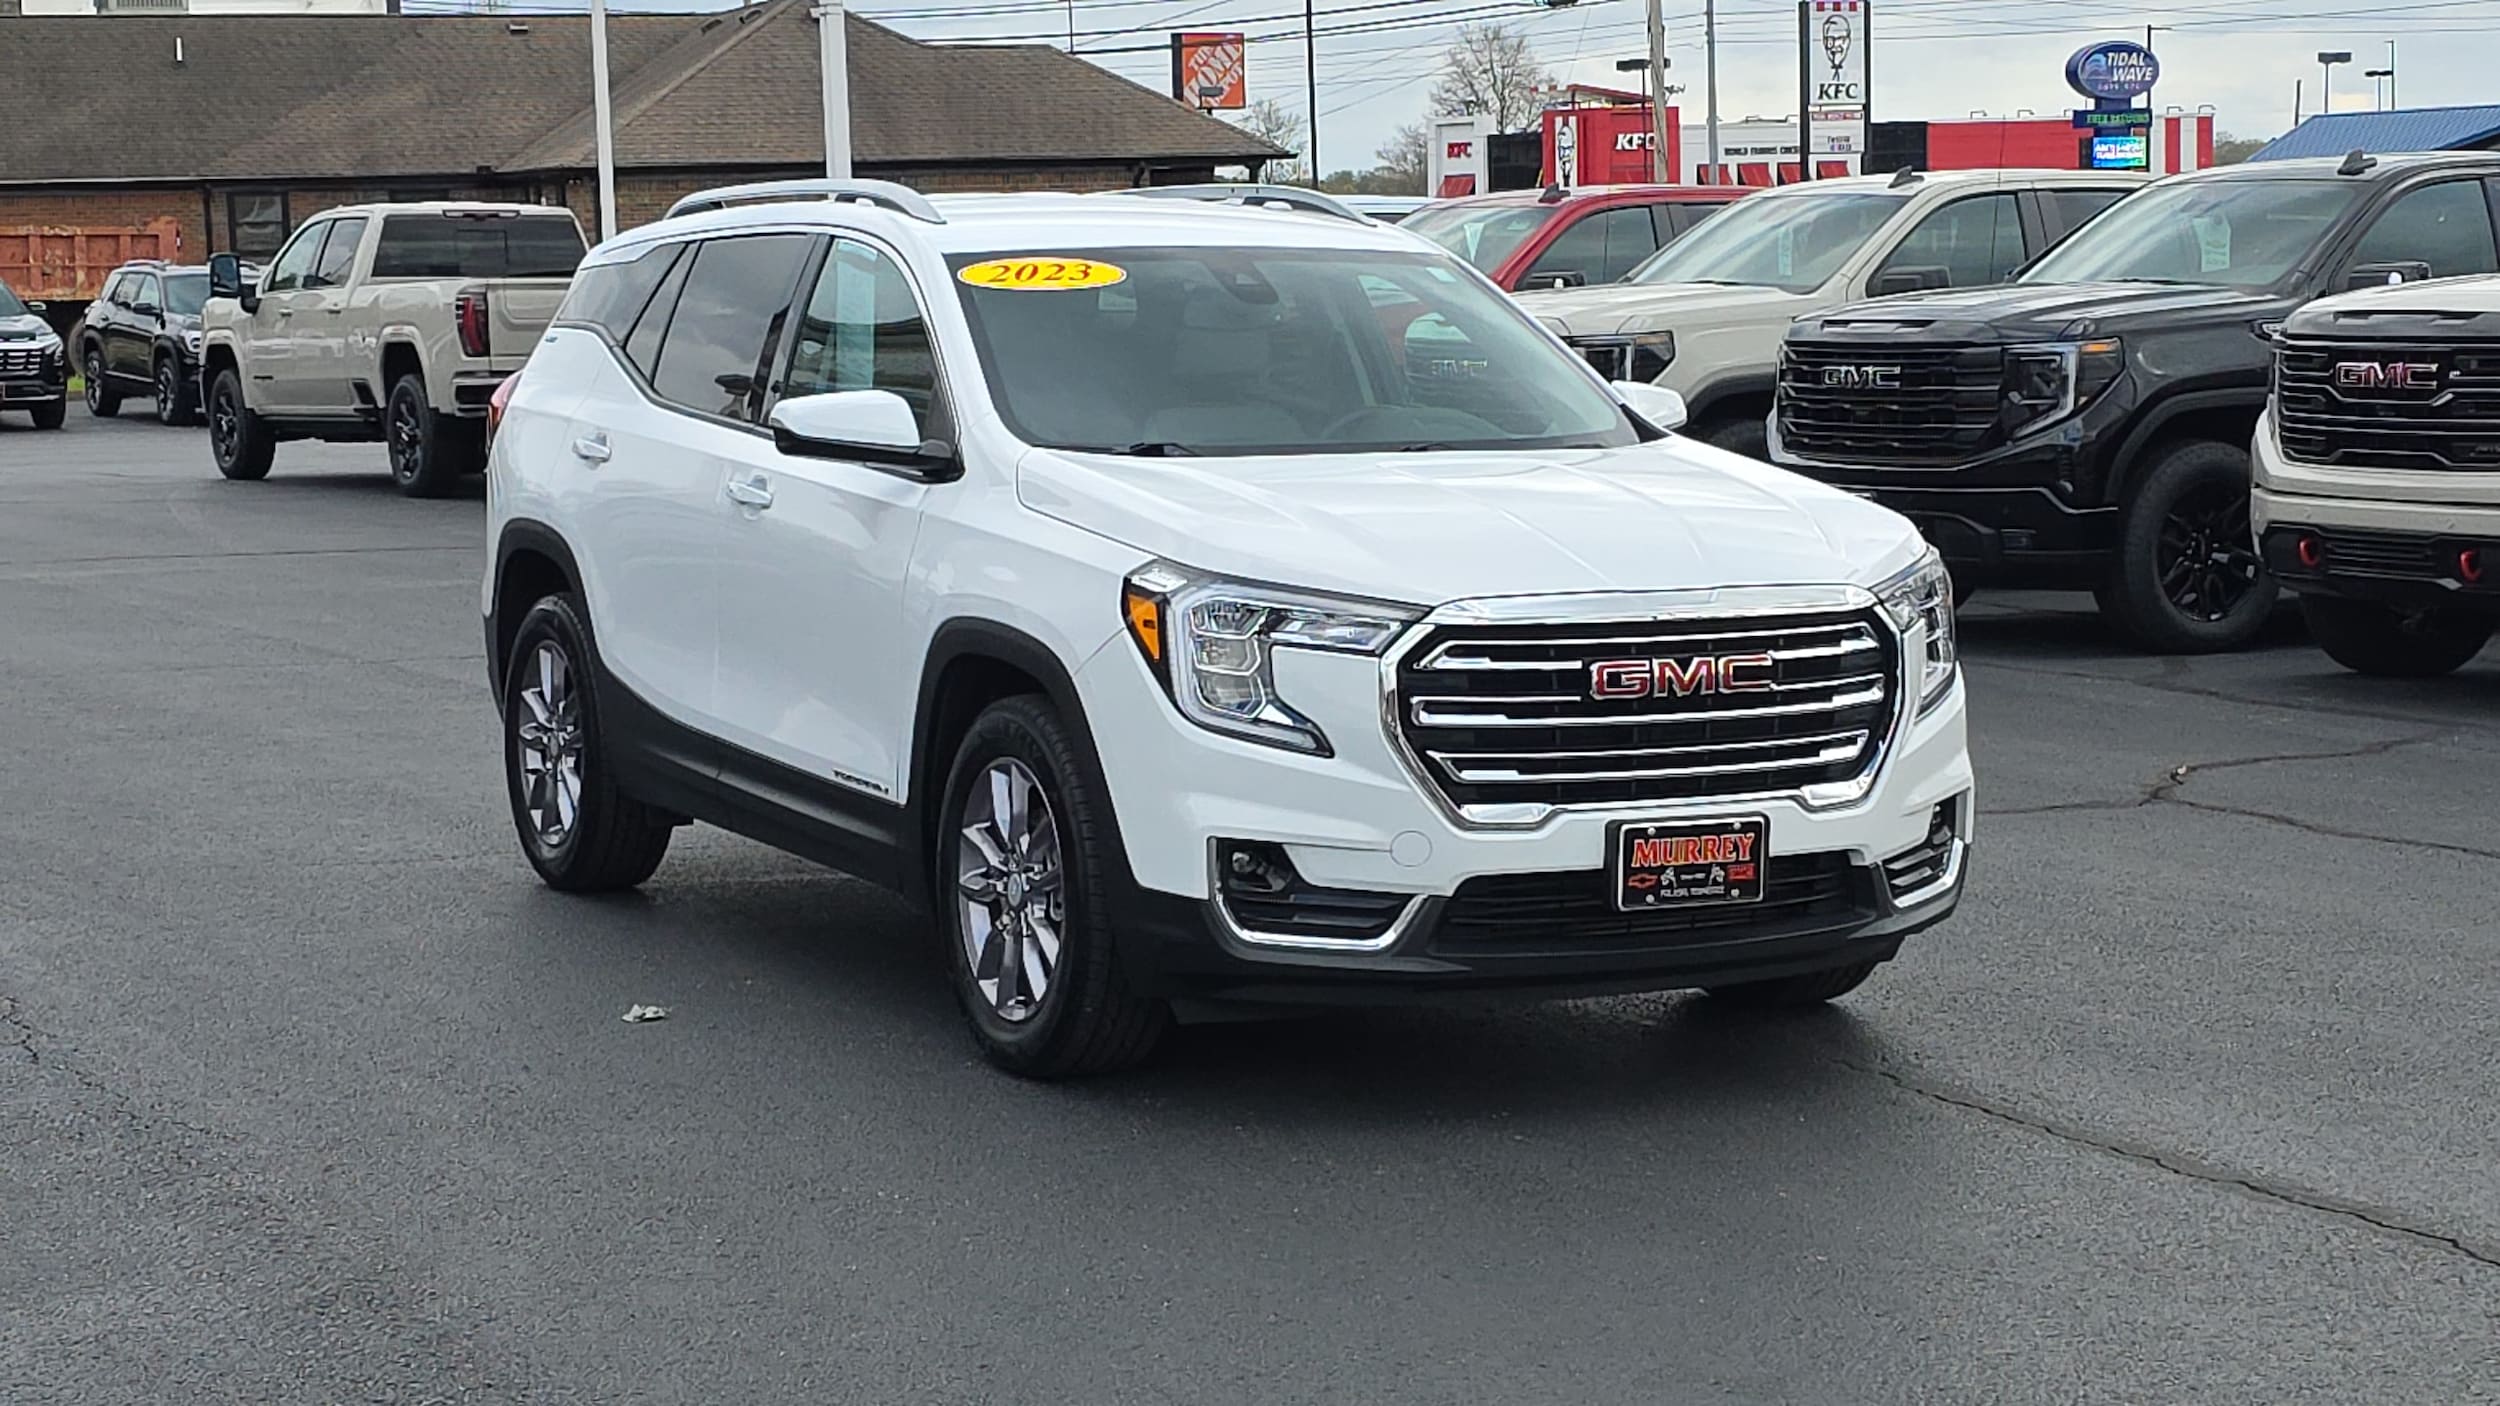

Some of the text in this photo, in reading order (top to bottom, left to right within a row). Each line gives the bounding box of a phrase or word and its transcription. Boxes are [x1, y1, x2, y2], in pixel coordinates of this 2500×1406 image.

[2107, 52, 2146, 67] TIDAL
[1183, 42, 1243, 108] HOME
[2112, 67, 2154, 82] WAVE
[1818, 83, 1858, 99] KFC
[987, 263, 1092, 283] 2023
[1822, 365, 1901, 389] GMC
[2336, 362, 2438, 389] GMC
[1590, 654, 1773, 700] GMC
[1631, 833, 1755, 868] MURREY
